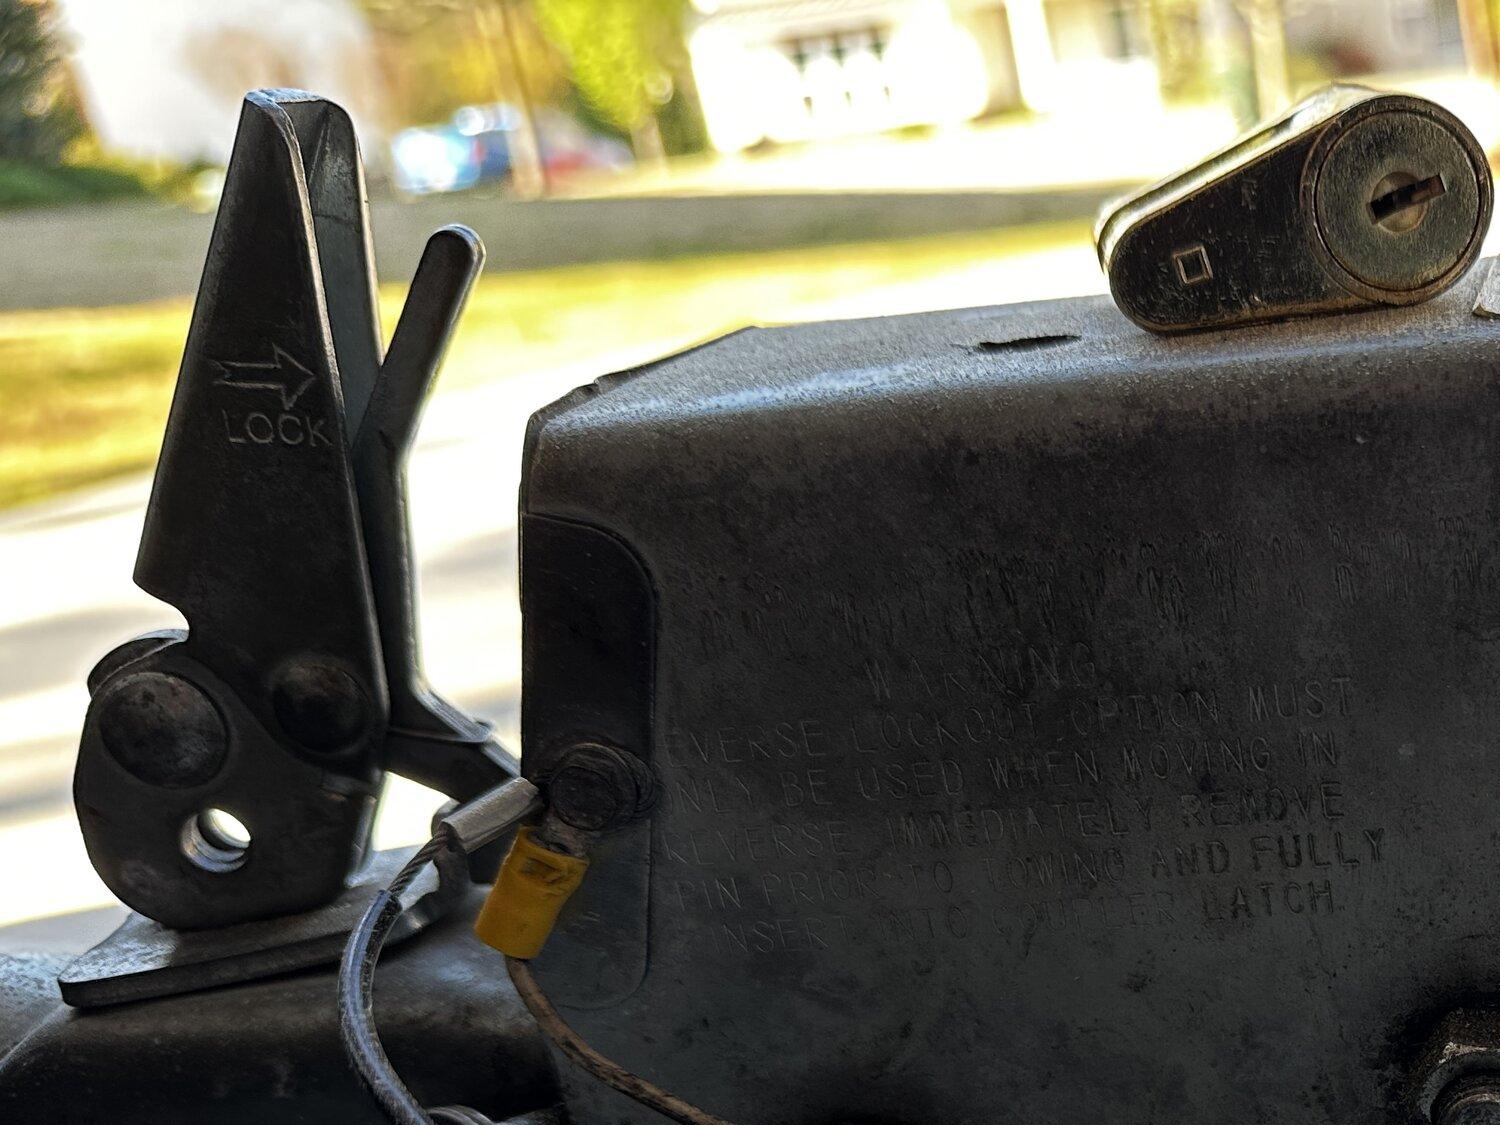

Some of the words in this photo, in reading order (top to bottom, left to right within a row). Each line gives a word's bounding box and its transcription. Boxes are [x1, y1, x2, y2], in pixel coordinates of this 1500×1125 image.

[222, 408, 334, 447] LOCK
[656, 718, 828, 768] EVERSE
[1247, 676, 1353, 723] MUST
[778, 767, 834, 806] BE
[855, 758, 964, 801] USED
[987, 749, 1100, 789] WHEN
[1122, 736, 1272, 782] MOVING
[1297, 729, 1338, 766] IN
[1180, 781, 1346, 829] REMOVE
[674, 875, 742, 911] PIN
[760, 861, 879, 904] PRIOR
[906, 859, 954, 893] TO
[980, 846, 1127, 894] TOWING
[1151, 840, 1231, 878] AND
[1250, 827, 1385, 872] FULLY
